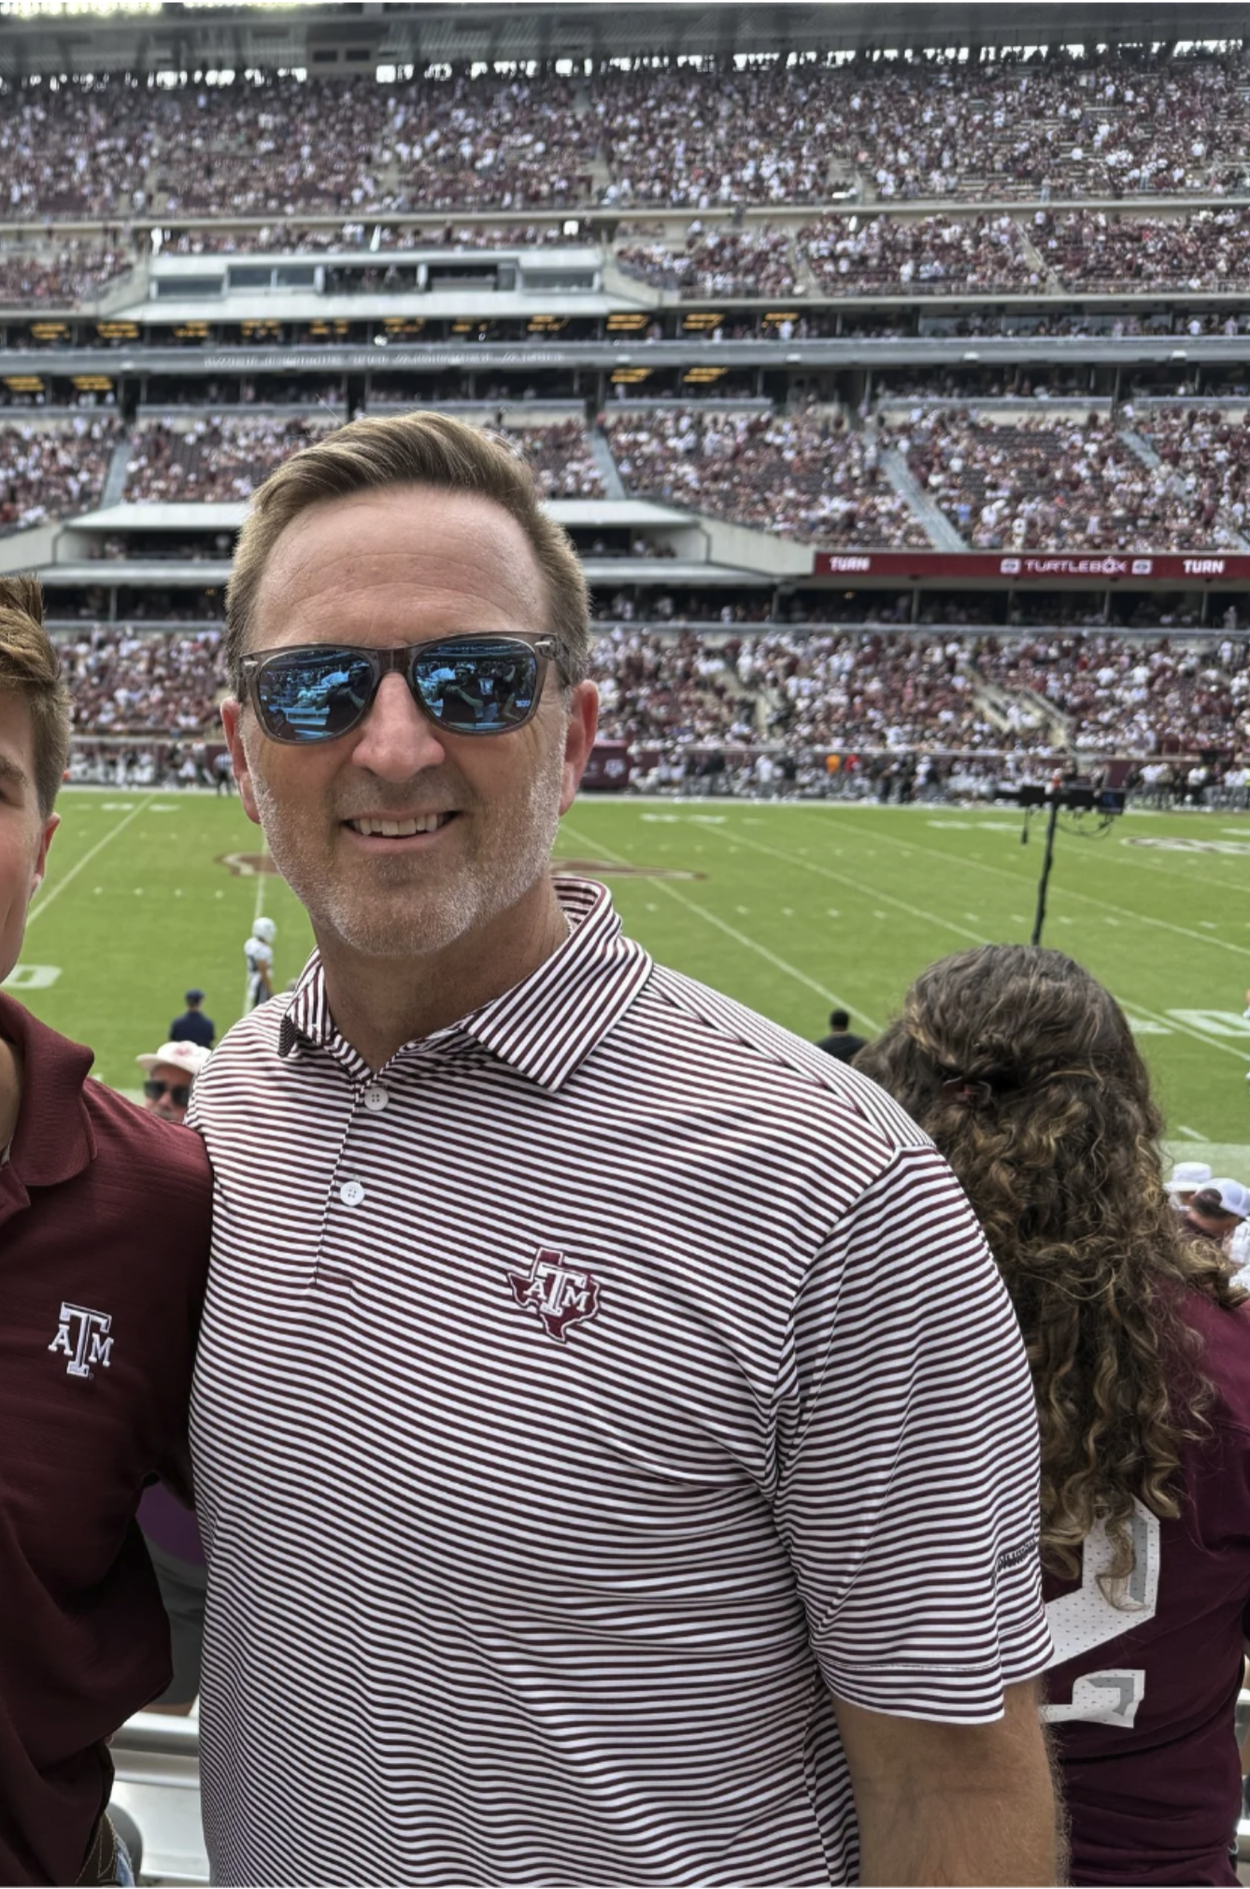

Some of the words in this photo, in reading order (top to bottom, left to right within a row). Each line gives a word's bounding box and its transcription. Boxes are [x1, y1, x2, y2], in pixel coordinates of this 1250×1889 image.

[829, 556, 871, 572] TURN
[1023, 555, 1129, 573] TURTLEBOX
[1183, 559, 1225, 574] TURN
